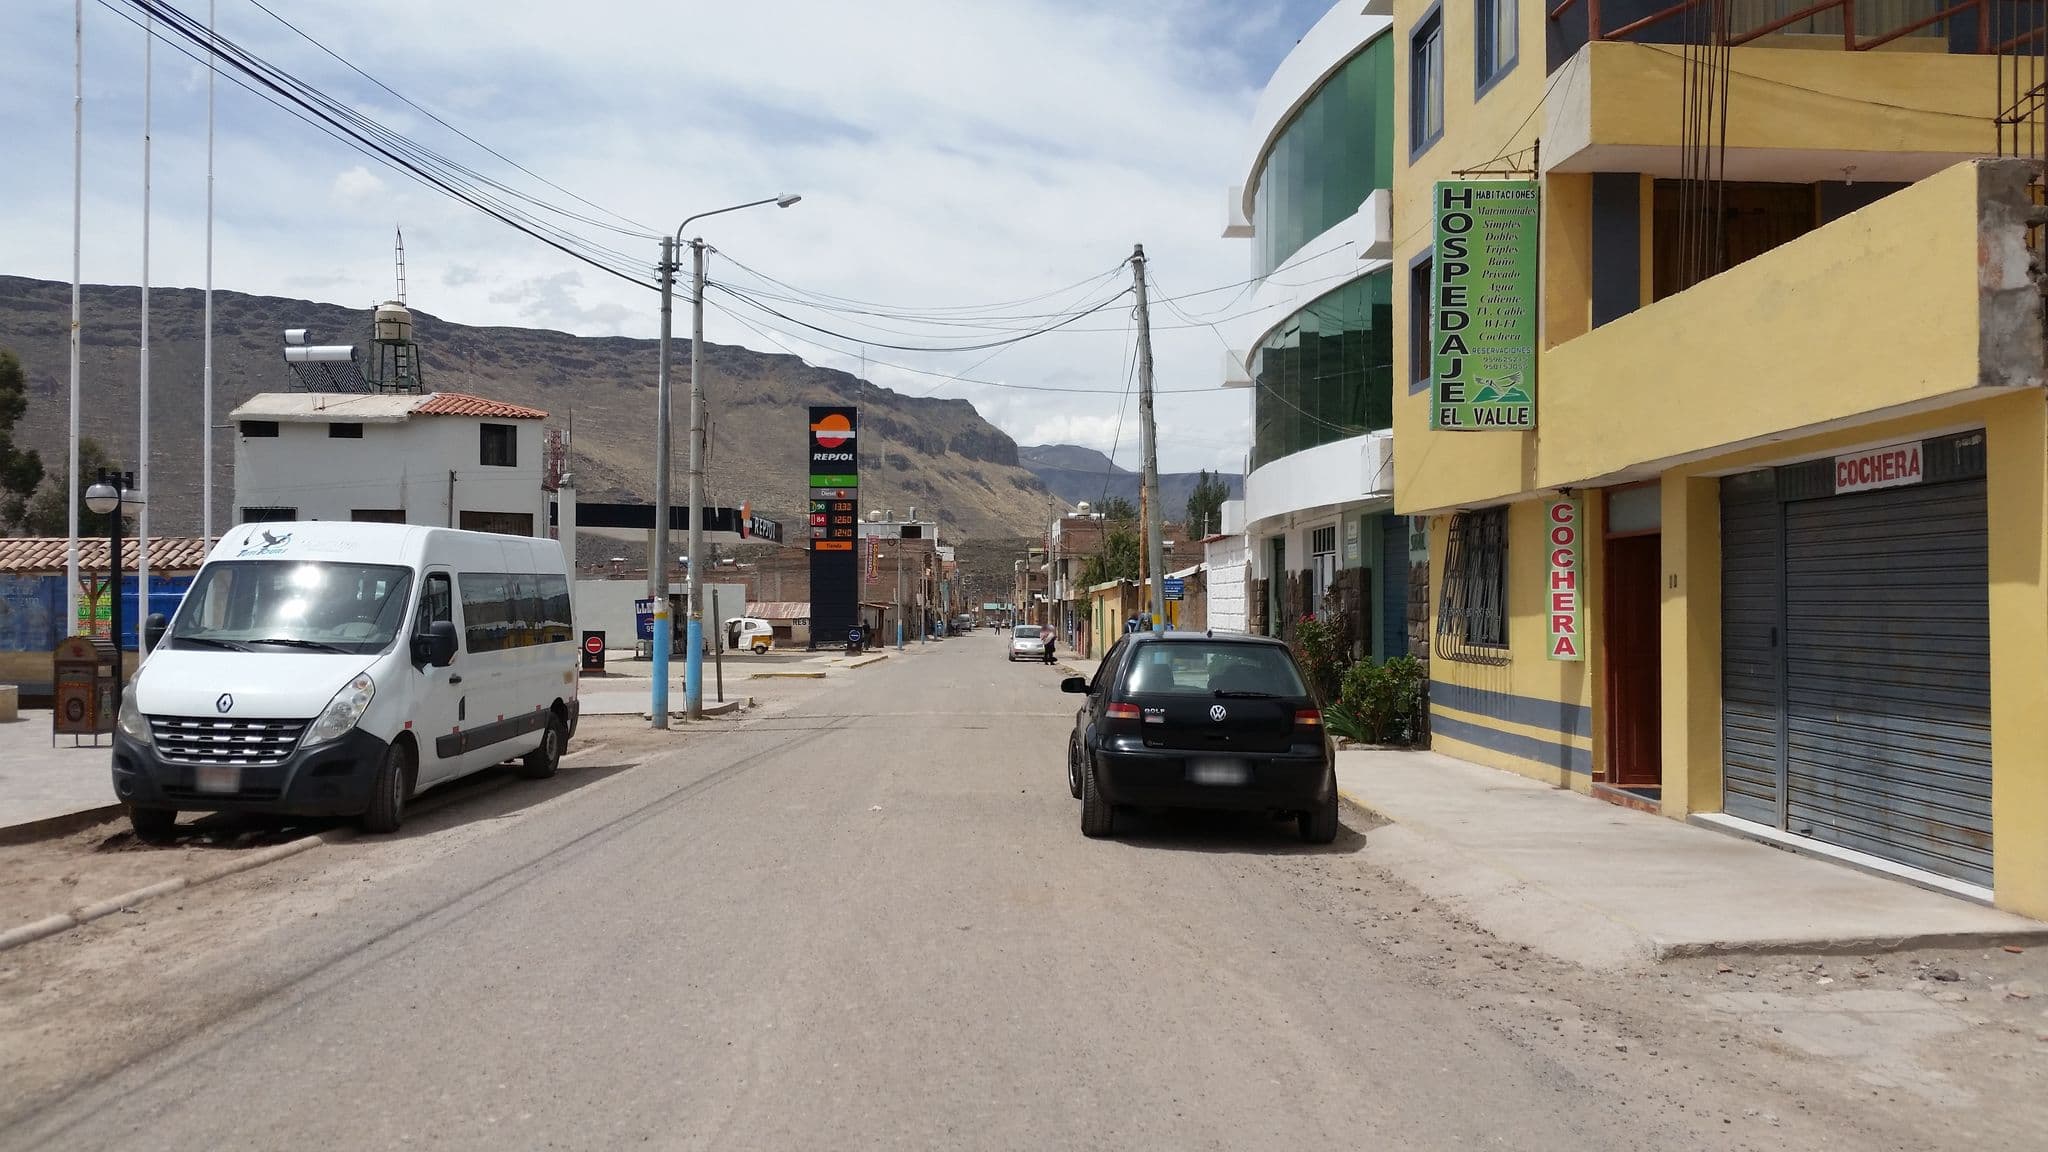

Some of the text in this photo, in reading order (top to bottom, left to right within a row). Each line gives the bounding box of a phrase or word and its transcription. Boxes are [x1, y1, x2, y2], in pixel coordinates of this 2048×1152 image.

[1476, 190, 1536, 200] HABITACIONES
[1477, 206, 1536, 216] Matrimoniales
[1482, 220, 1521, 231] Simples
[1485, 232, 1519, 241] Dobles
[1486, 245, 1519, 255] Triples
[1488, 256, 1515, 266] Baño
[1482, 270, 1520, 279] Privado
[1490, 283, 1514, 293] Agua
[1439, 188, 1473, 403] HOSPEDAJE
[1480, 295, 1522, 304] Caliente
[1497, 307, 1524, 315] Cable
[1479, 332, 1520, 341] Cochera
[1472, 347, 1531, 355] RESERVACIONES
[1441, 408, 1529, 425] EL VALLE
[813, 453, 855, 461] REPSOL
[1837, 448, 1921, 488] COCHERA
[816, 503, 826, 511] 90
[752, 516, 776, 540] REPSOL
[1551, 503, 1576, 656] COCHERA
